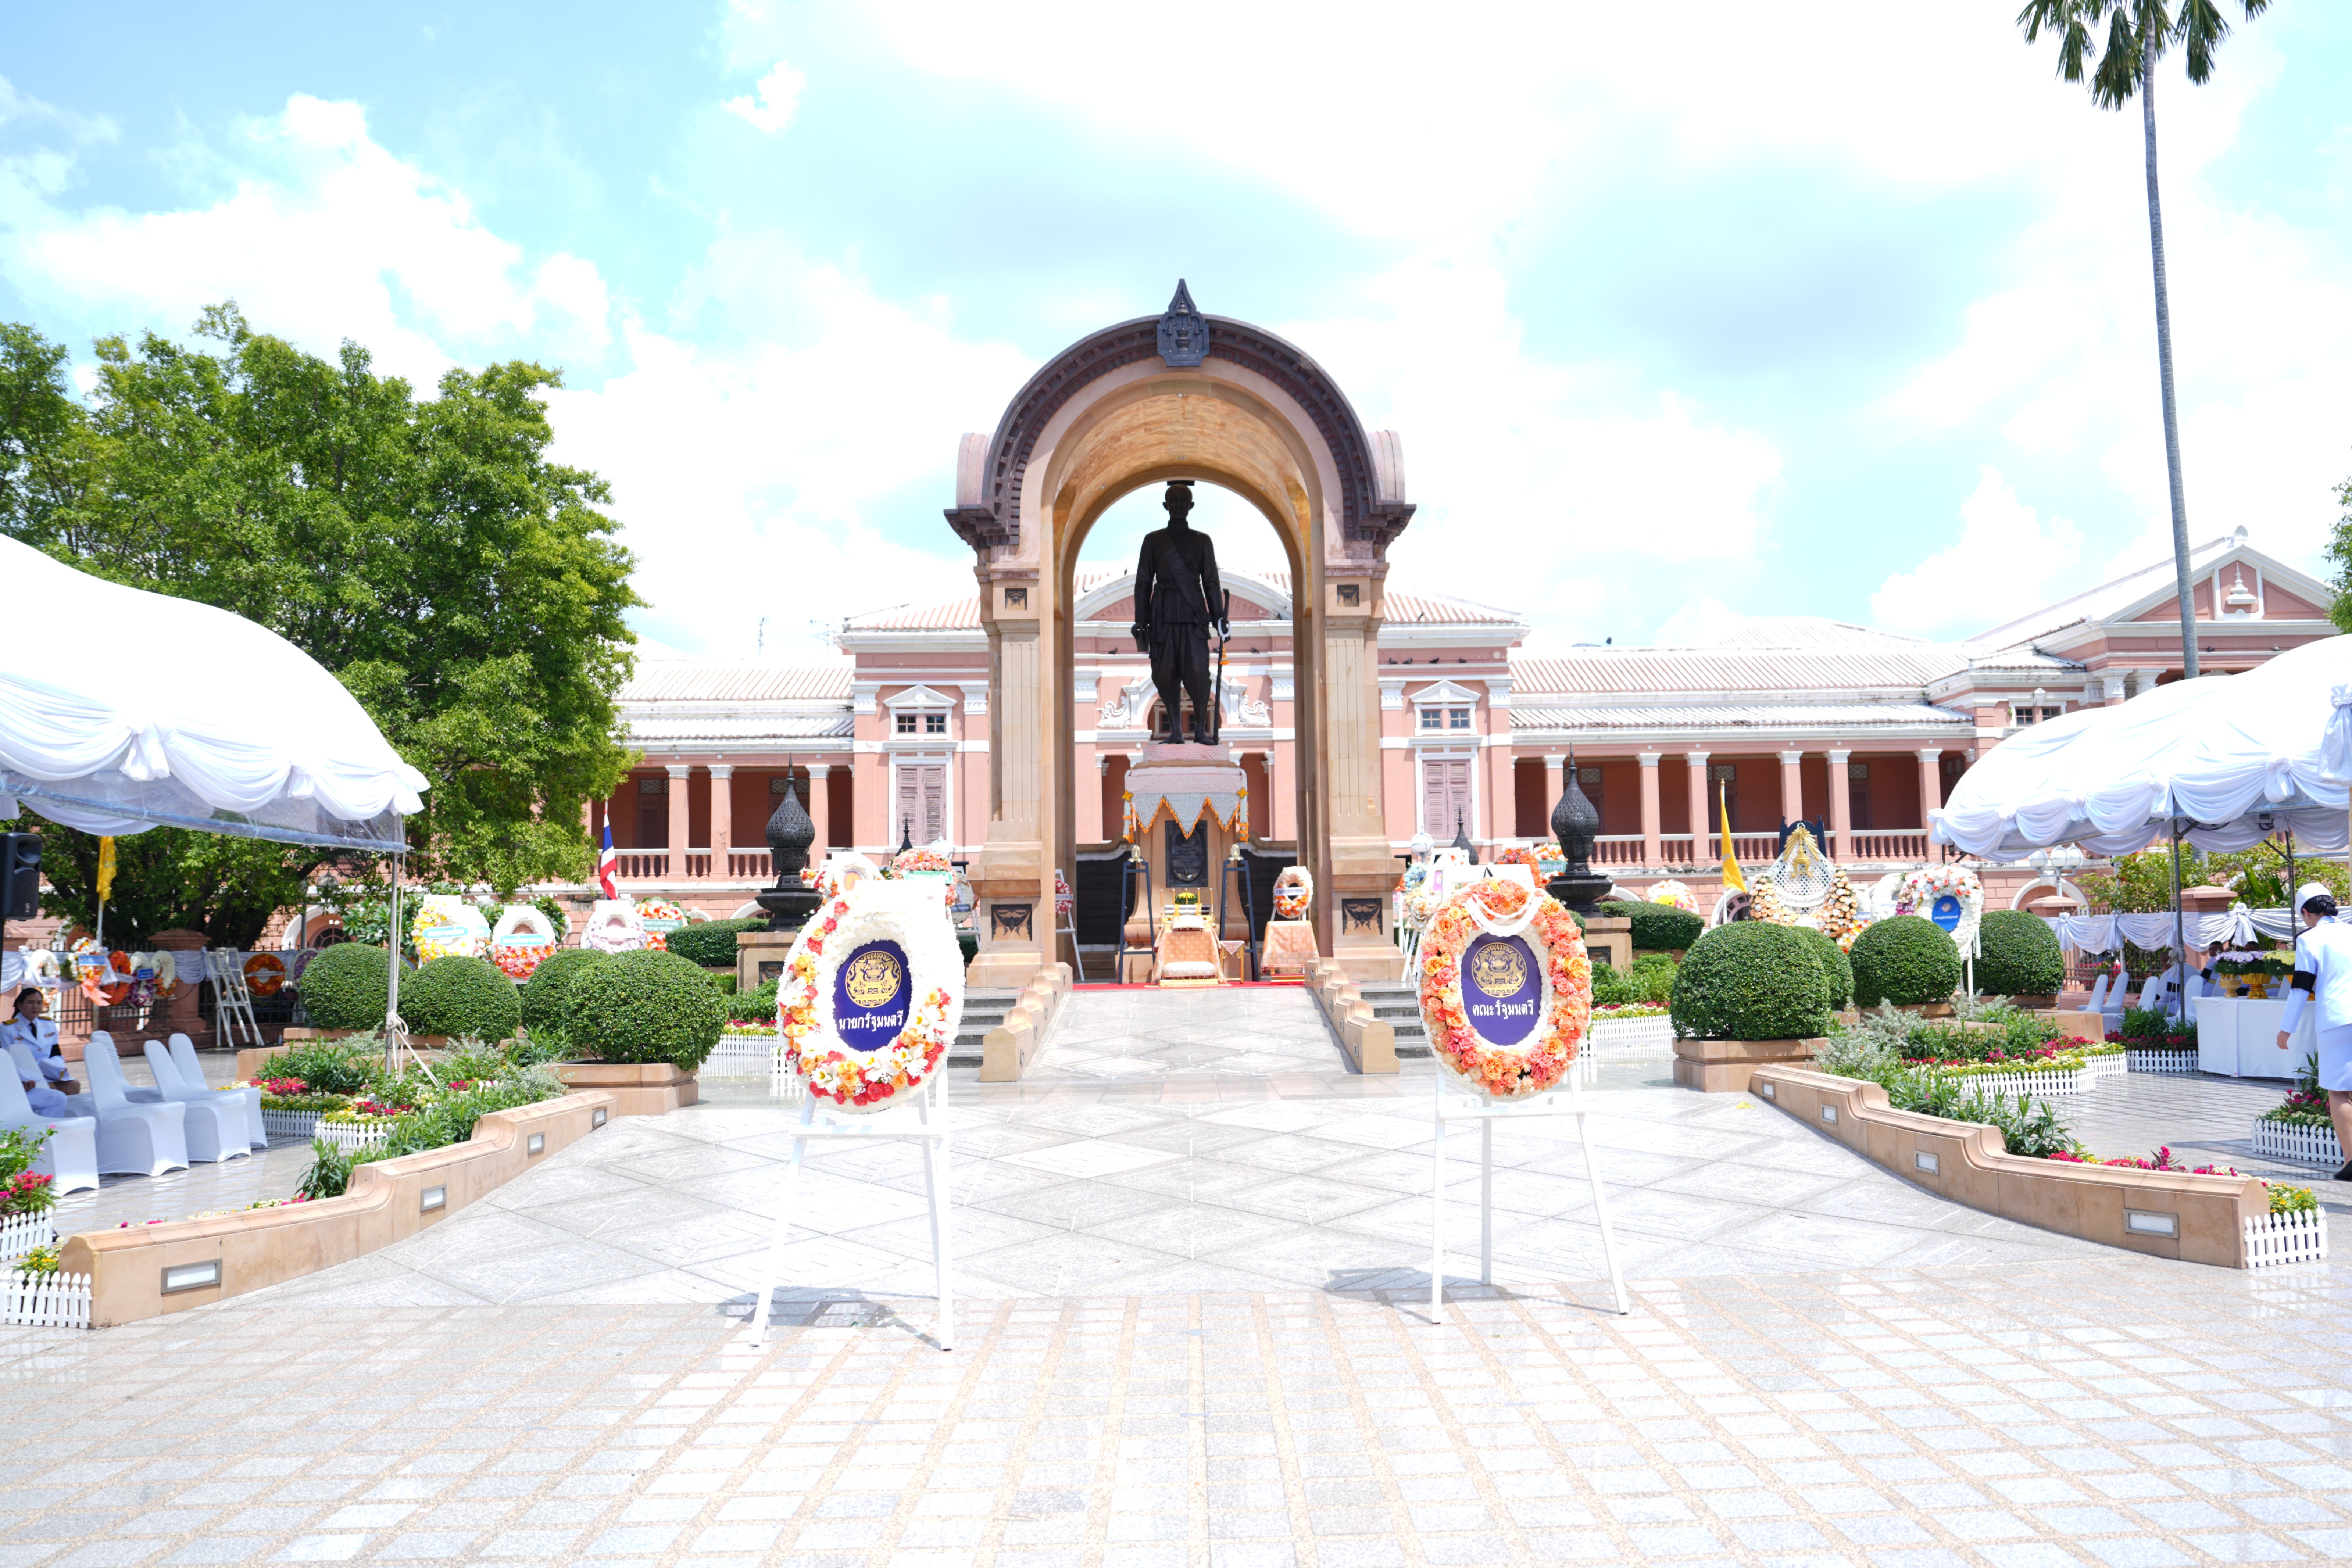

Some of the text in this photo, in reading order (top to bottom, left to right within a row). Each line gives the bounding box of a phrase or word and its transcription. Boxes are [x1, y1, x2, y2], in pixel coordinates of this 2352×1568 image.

[1779, 893, 1824, 903] หน่วยราชการในพระอง
[1472, 999, 1534, 1019] คณะรัฐมนตรี
[839, 1010, 904, 1032] นายกรัฐมนตรี
